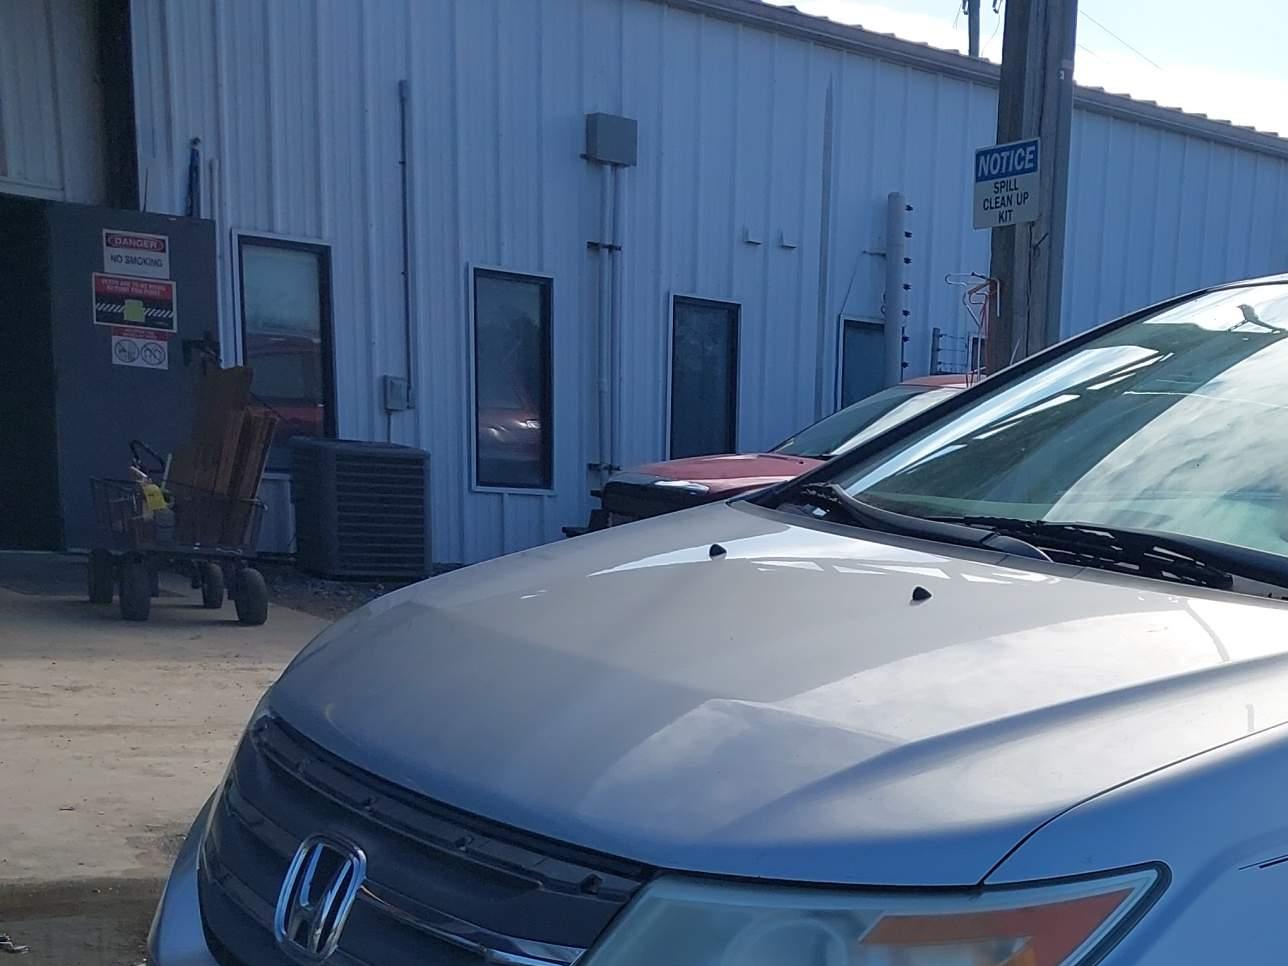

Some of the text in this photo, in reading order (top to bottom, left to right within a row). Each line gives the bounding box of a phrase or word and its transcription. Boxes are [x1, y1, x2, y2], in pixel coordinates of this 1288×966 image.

[978, 145, 1036, 177] NOTICE
[993, 178, 1019, 194] SPILL
[983, 191, 1030, 211] CLEAN UP
[998, 209, 1014, 224] KIT
[114, 236, 158, 249] DANGER
[110, 253, 163, 267] NO SMOKING
